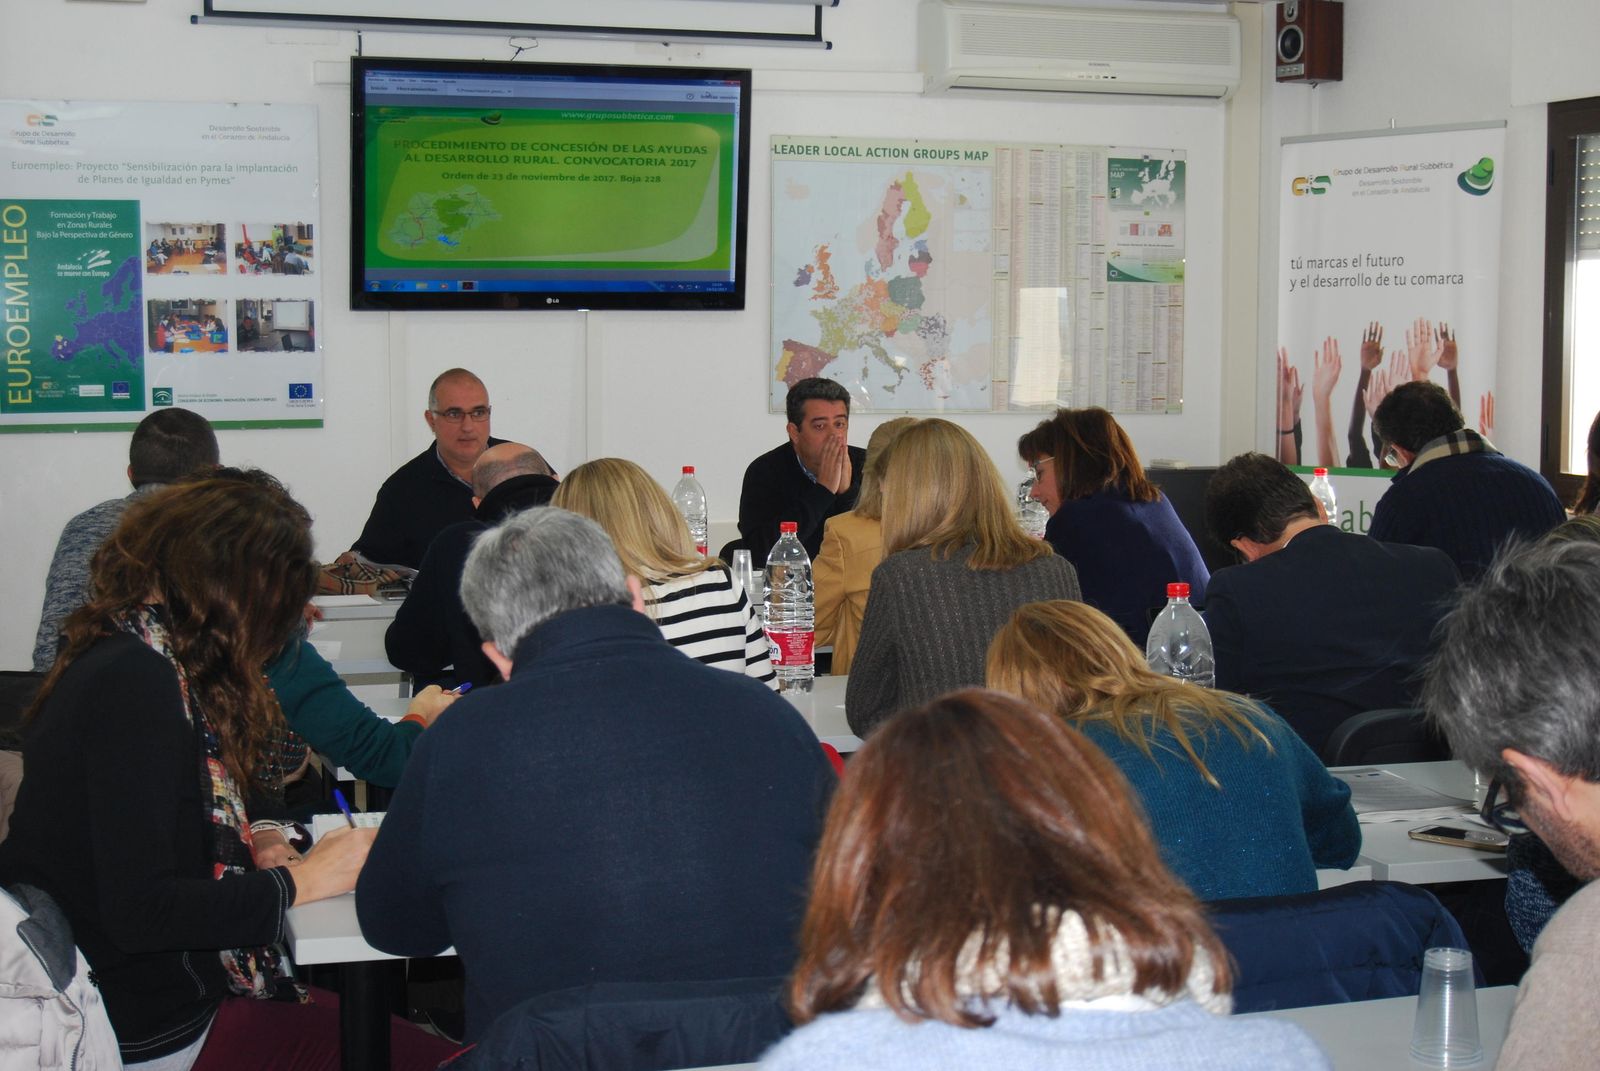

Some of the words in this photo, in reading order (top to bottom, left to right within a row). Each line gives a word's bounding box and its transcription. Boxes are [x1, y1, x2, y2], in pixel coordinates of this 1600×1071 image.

[561, 111, 674, 121] www.gruposubbetica.com
[393, 139, 506, 151] PROCEDIMIENTO
[511, 142, 527, 151] DE
[531, 141, 608, 153] CONCESIÓN
[613, 144, 629, 153] DE
[633, 144, 654, 153] LAS
[657, 145, 708, 155] AYUDAS
[773, 144, 820, 156] LEADER
[824, 146, 862, 157] LOCAL
[866, 147, 909, 158] ACTION
[913, 149, 960, 160] GROUPS
[964, 151, 989, 161] MAP
[404, 153, 421, 162] AL
[425, 154, 509, 164] DESARROLLO
[513, 155, 560, 165] RURAL.
[564, 156, 666, 167] CONVOCATORIA
[670, 159, 697, 168] 2017
[11, 161, 73, 173] Euroempleo:
[76, 161, 119, 173] Proyecto
[201, 164, 222, 174] para
[225, 163, 233, 172] la
[1333, 168, 1353, 177] Grupo
[1363, 164, 1398, 174] Desarrollo
[78, 175, 89, 184] de
[93, 175, 124, 185] Planes
[126, 175, 138, 185] de
[141, 175, 183, 187] Igualdad
[185, 177, 197, 185] en
[441, 172, 474, 180] Orden
[477, 172, 489, 180] de
[506, 172, 518, 181] de
[521, 172, 576, 182] noviembre
[578, 174, 591, 182] de
[620, 174, 641, 184] Boja
[645, 175, 661, 183] 228
[50, 211, 86, 219] Formación
[92, 211, 117, 220] Trabajo
[67, 221, 87, 229] Zonas
[88, 221, 112, 229] Rurales
[36, 231, 51, 240] Bajo
[60, 231, 98, 240] Perspectiva
[99, 231, 108, 239] de
[108, 231, 134, 239] Género
[1290, 256, 1303, 270] tú
[1306, 257, 1348, 269] marcas
[1351, 254, 1362, 268] el
[1366, 253, 1405, 267] futuro
[1289, 278, 1297, 292] y
[1300, 274, 1310, 288] el
[1313, 273, 1372, 288] desarrollo
[1375, 272, 1390, 286] de
[1393, 274, 1406, 286] tu
[1410, 273, 1464, 286] comarca
[2, 204, 33, 404] EUROEMPLEO
